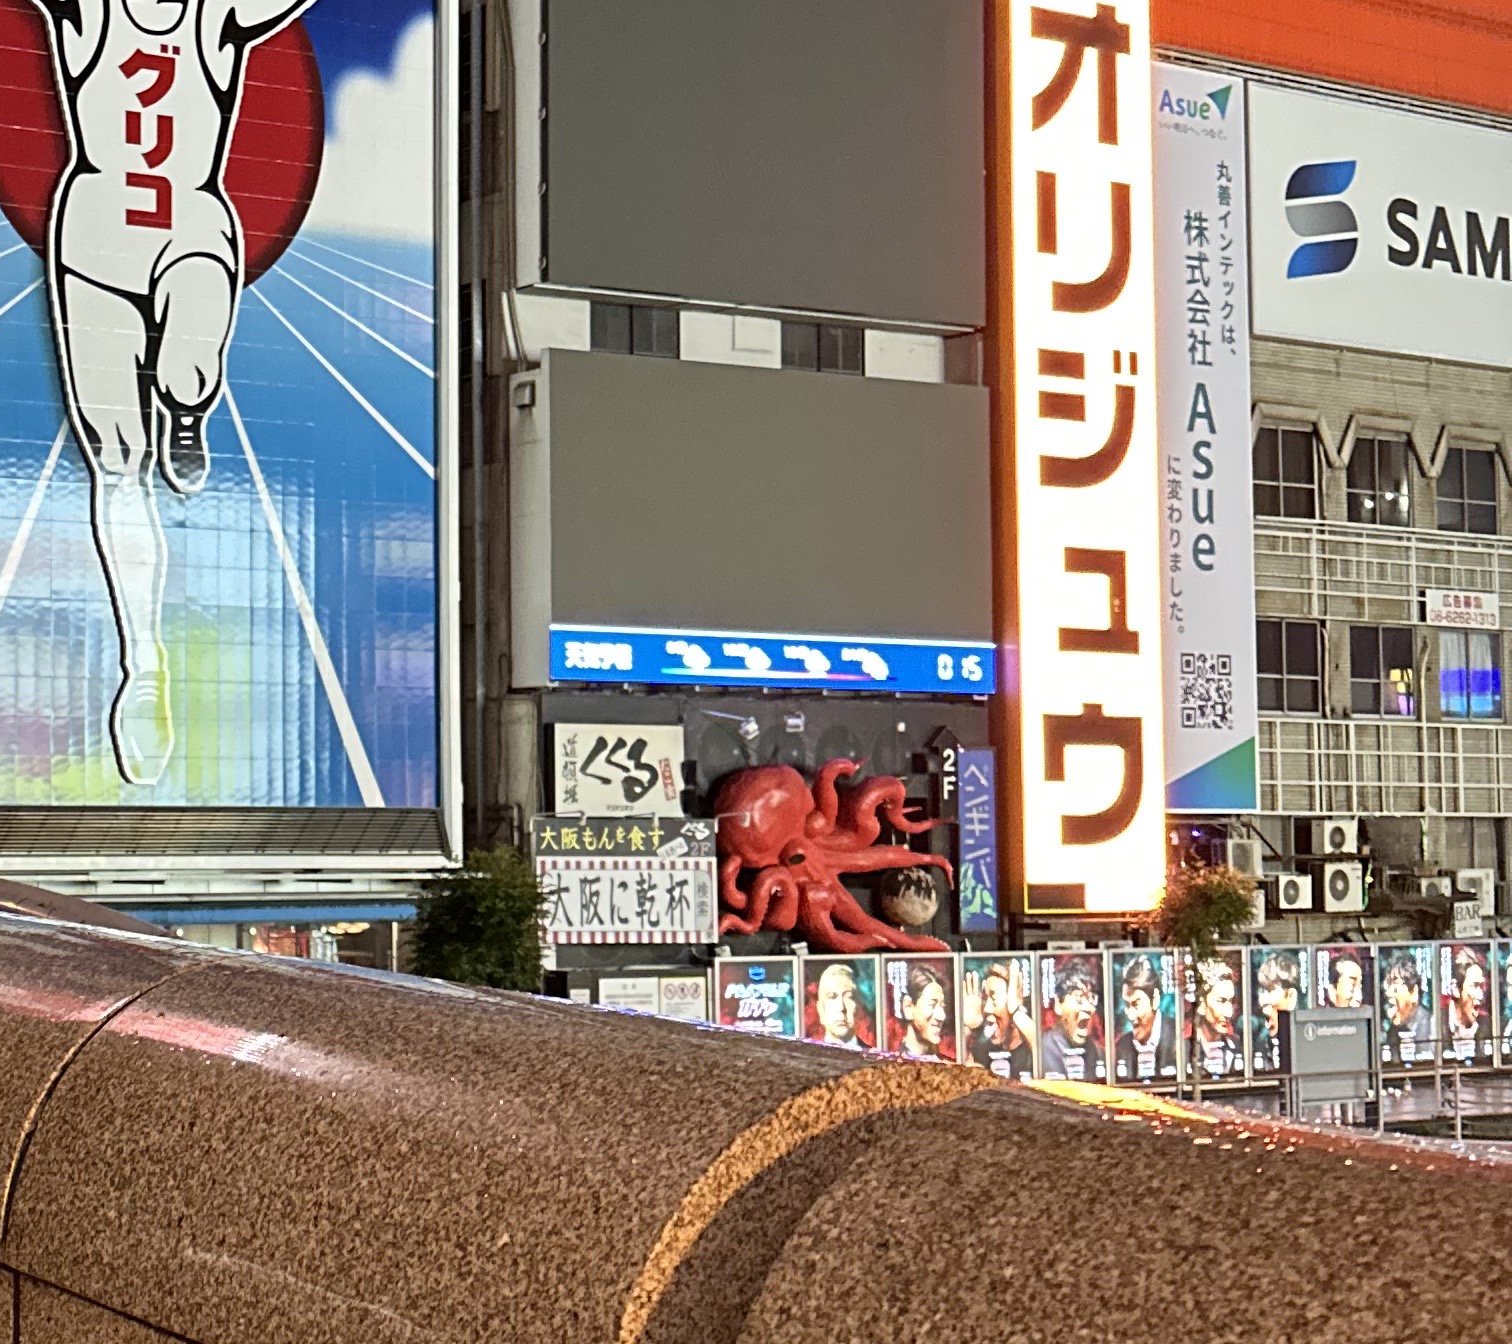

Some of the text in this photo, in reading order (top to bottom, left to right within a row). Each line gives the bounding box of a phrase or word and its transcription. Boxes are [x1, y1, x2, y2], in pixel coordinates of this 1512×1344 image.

[118, 43, 181, 231] グリコ
[1159, 88, 1211, 120] Asue
[1215, 160, 1237, 356] 丸善インテックは、
[1386, 197, 1511, 282] SAM
[1029, 1, 1144, 846] オリジュウ
[1166, 453, 1186, 635] に変わりました。
[578, 735, 659, 804] くくる
[539, 824, 665, 851] 大阪もんを食す
[690, 841, 713, 857] 2F
[546, 872, 691, 930] 大阪に乾杯
[1456, 903, 1482, 922] BAR
